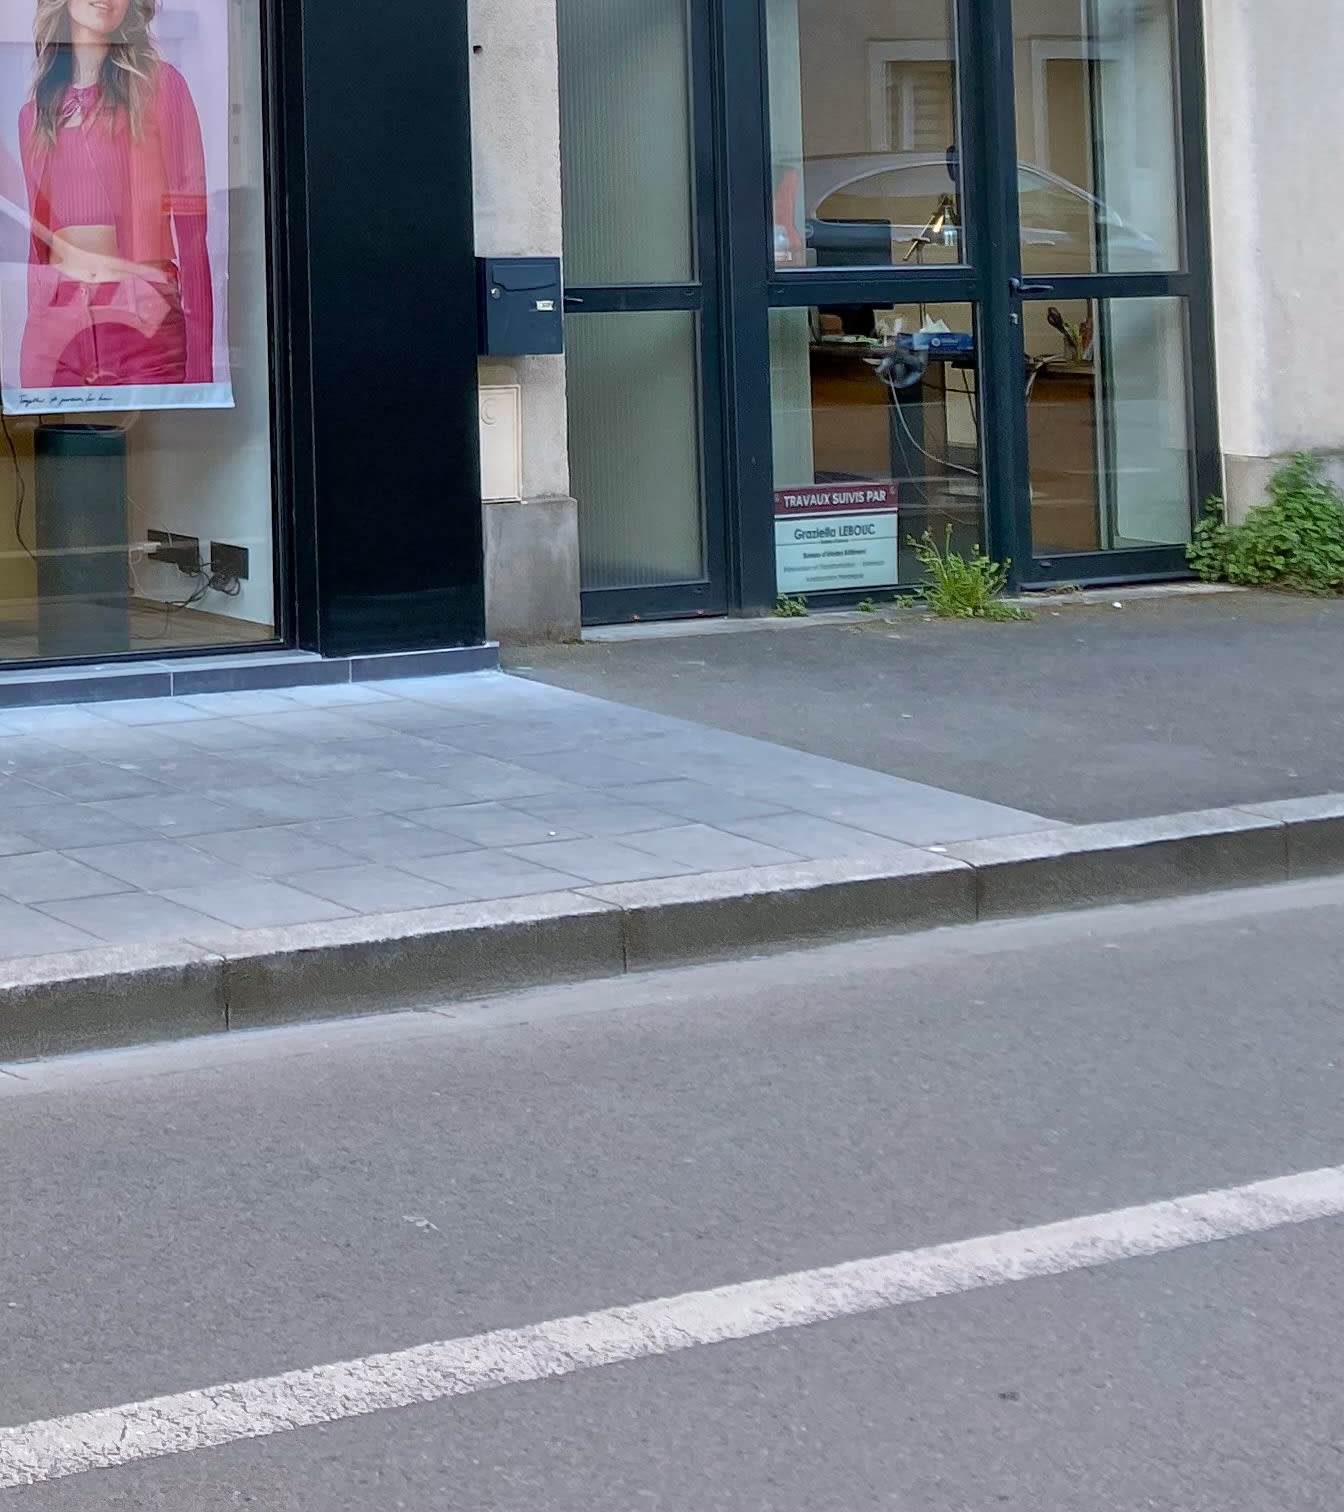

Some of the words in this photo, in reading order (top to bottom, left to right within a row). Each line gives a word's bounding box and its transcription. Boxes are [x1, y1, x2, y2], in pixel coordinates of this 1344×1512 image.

[784, 493, 830, 508] TRAVAUX
[831, 491, 864, 505] SUIVIS
[866, 490, 886, 502] PAR
